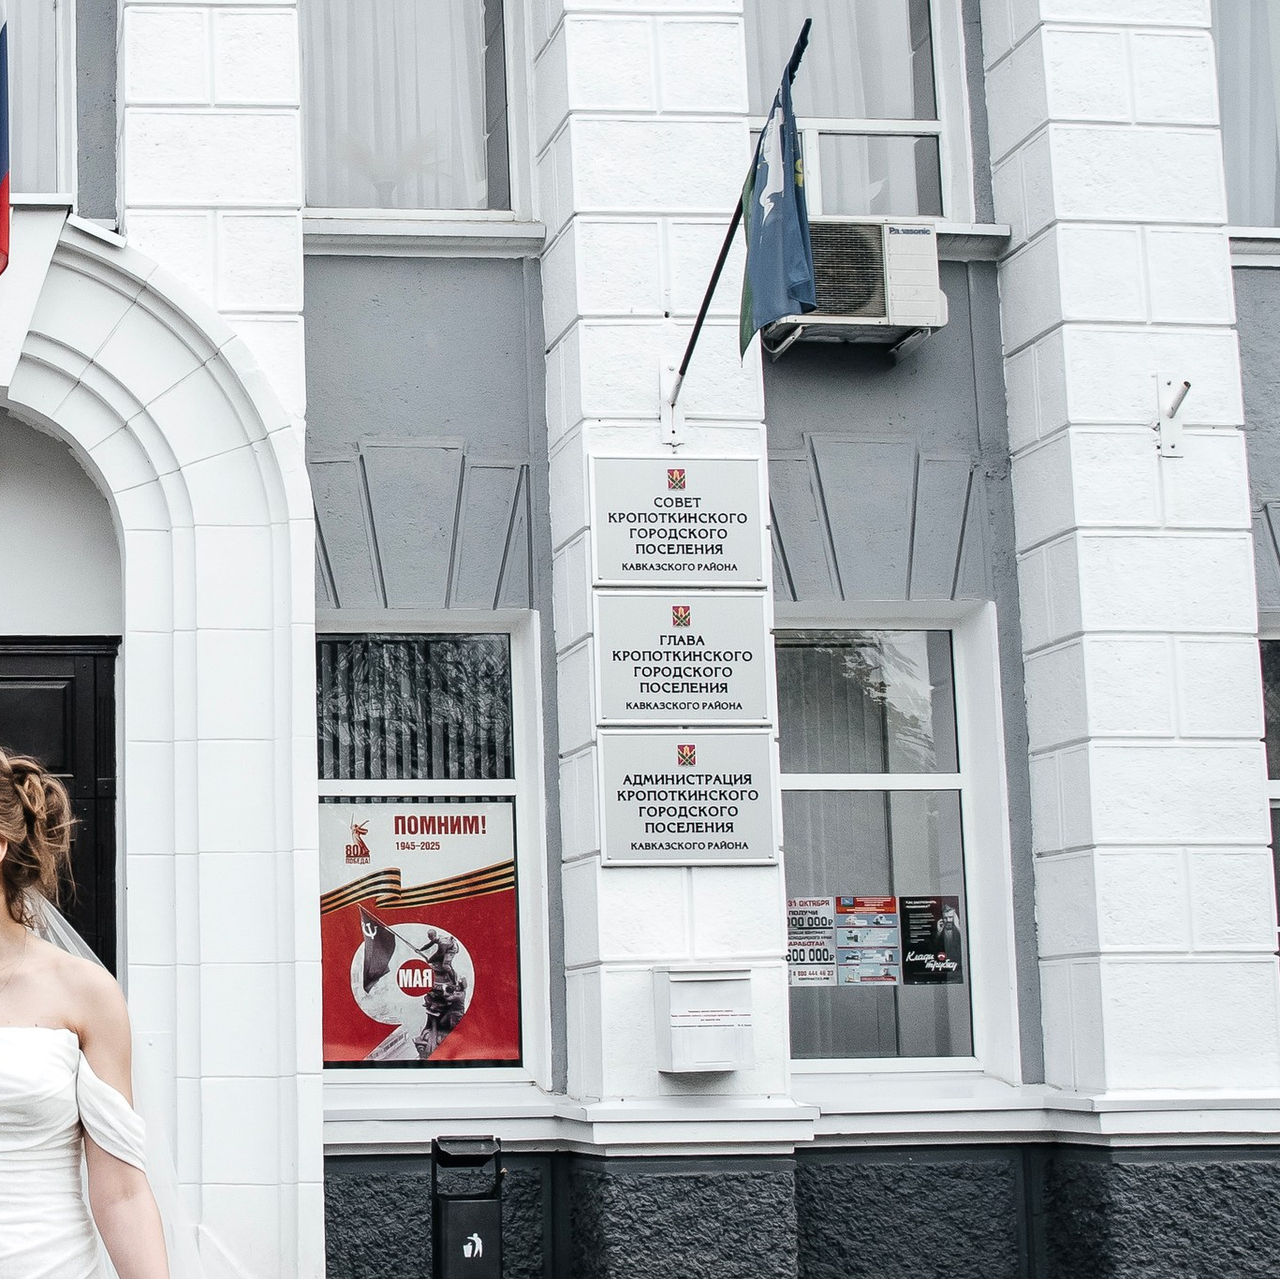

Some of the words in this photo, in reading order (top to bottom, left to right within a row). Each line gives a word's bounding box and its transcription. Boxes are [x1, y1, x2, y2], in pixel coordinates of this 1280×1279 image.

[653, 496, 702, 508] СОВЕТ
[608, 511, 748, 524] КРОПОТКИНСКОГО
[629, 527, 728, 541] ГОРОДСКОГО
[635, 543, 724, 555] ПОСЕЛЕНИЯ
[621, 561, 696, 572] КАВКАЗСКОГО
[697, 561, 738, 572] РАЙОНА
[659, 634, 706, 646] ГЛАВА
[612, 650, 753, 663] КРОПОТКИНСКОГО
[633, 666, 733, 679] ГОРОДСКОГО
[639, 682, 728, 694] ПОСЕЛЕНИЯ
[625, 700, 700, 711] КАВКАЗСКОГО
[701, 700, 743, 711] РАЙОНА
[622, 773, 752, 788] АДМИНИСТРАЦИЯ
[616, 789, 759, 802] КРОПОТКИНСКОГО
[638, 805, 739, 819] ГОРОДСКОГО
[394, 815, 487, 835] ПОМНИМ!
[644, 821, 734, 834] ПОСЕЛЕНИЯ
[345, 844, 359, 857] 80
[630, 840, 706, 851] КАВКАЗСКОГО
[707, 840, 749, 851] РАЙОНА
[798, 899, 830, 907] ОКТЯБРЯ
[905, 950, 935, 963] Клади
[399, 968, 433, 988] МАЯ
